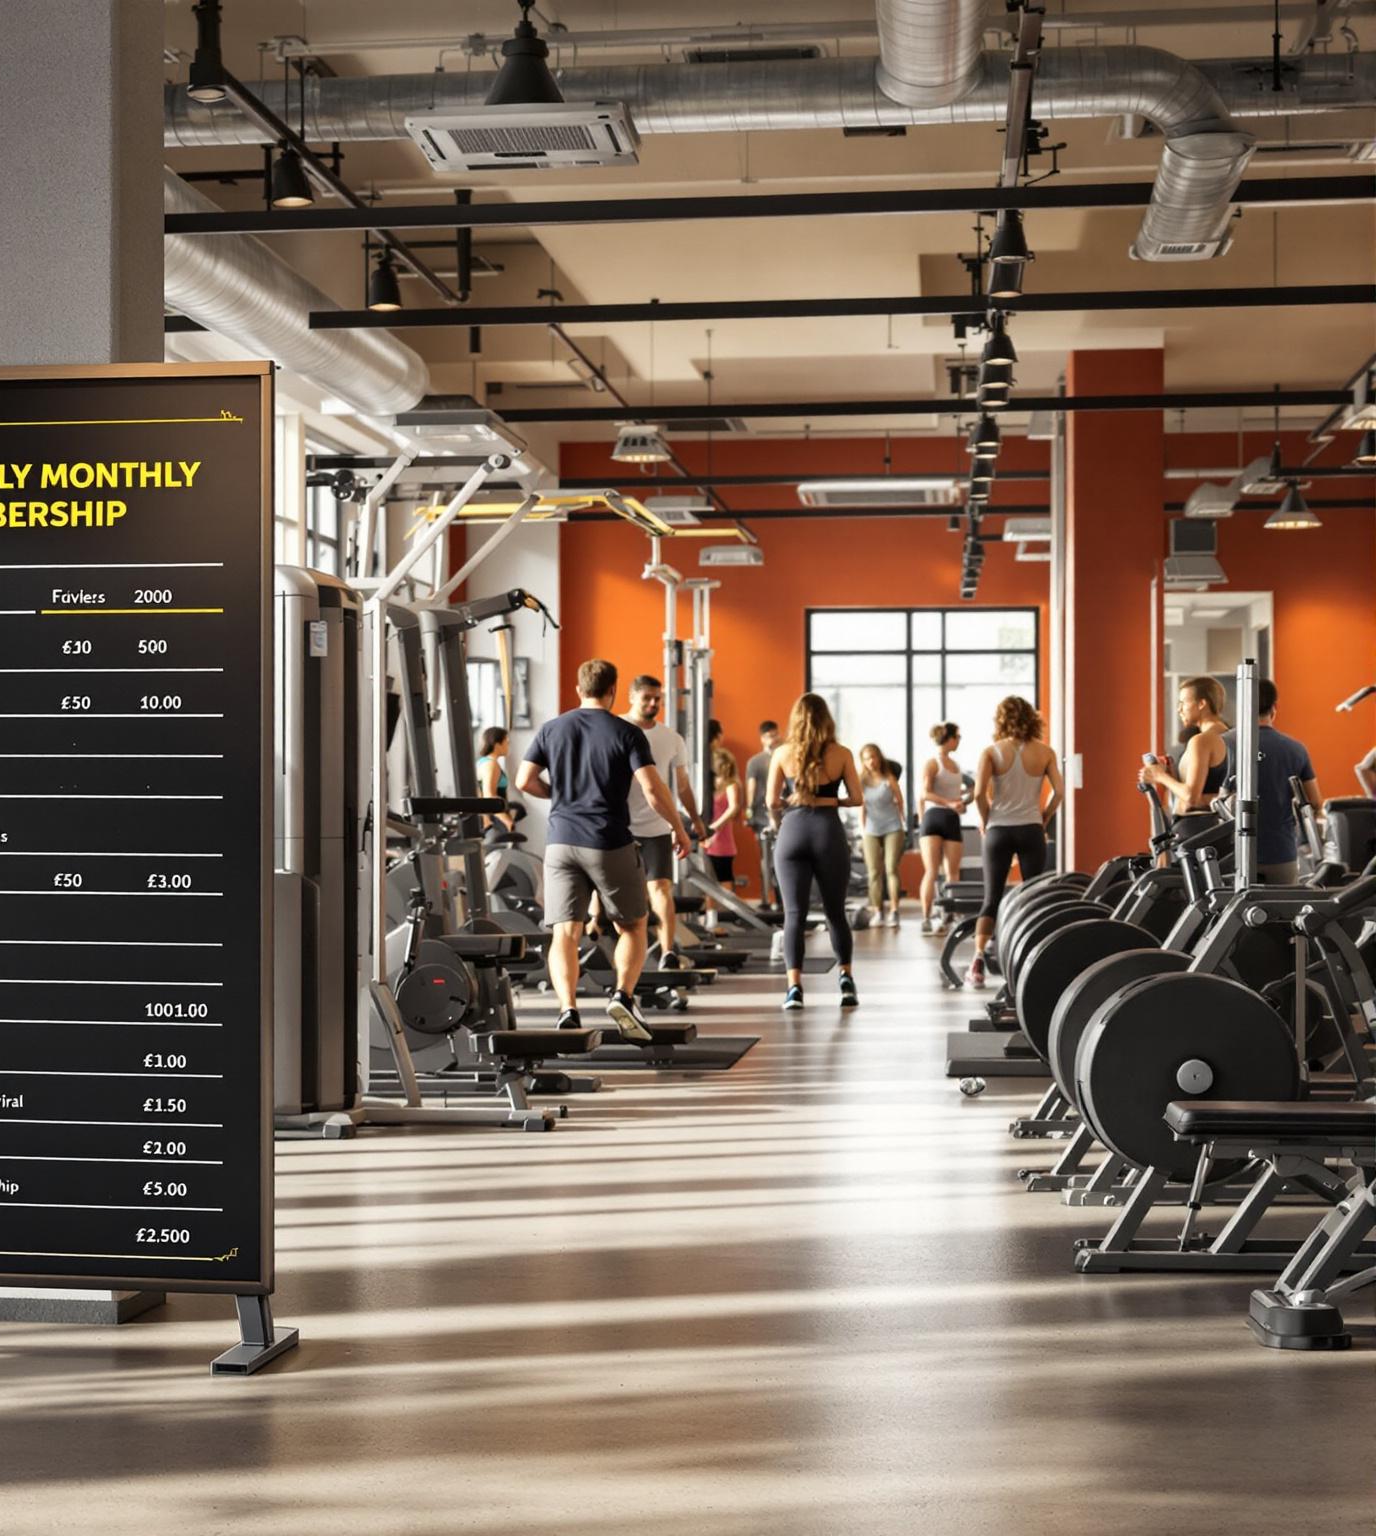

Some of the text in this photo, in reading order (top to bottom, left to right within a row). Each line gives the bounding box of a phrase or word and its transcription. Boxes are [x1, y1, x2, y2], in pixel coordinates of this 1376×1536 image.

[40, 461, 202, 489] MONTHLY
[134, 589, 173, 604] 2000
[61, 695, 91, 710] £50
[140, 695, 182, 710] 10.00
[53, 873, 83, 888] £50
[147, 873, 192, 889] £3.00
[145, 1002, 208, 1018] 1001.00
[143, 1053, 187, 1069] £1.00
[142, 1098, 187, 1113] £1.50
[142, 1140, 187, 1156] £2.00
[142, 1181, 188, 1197] £5.00
